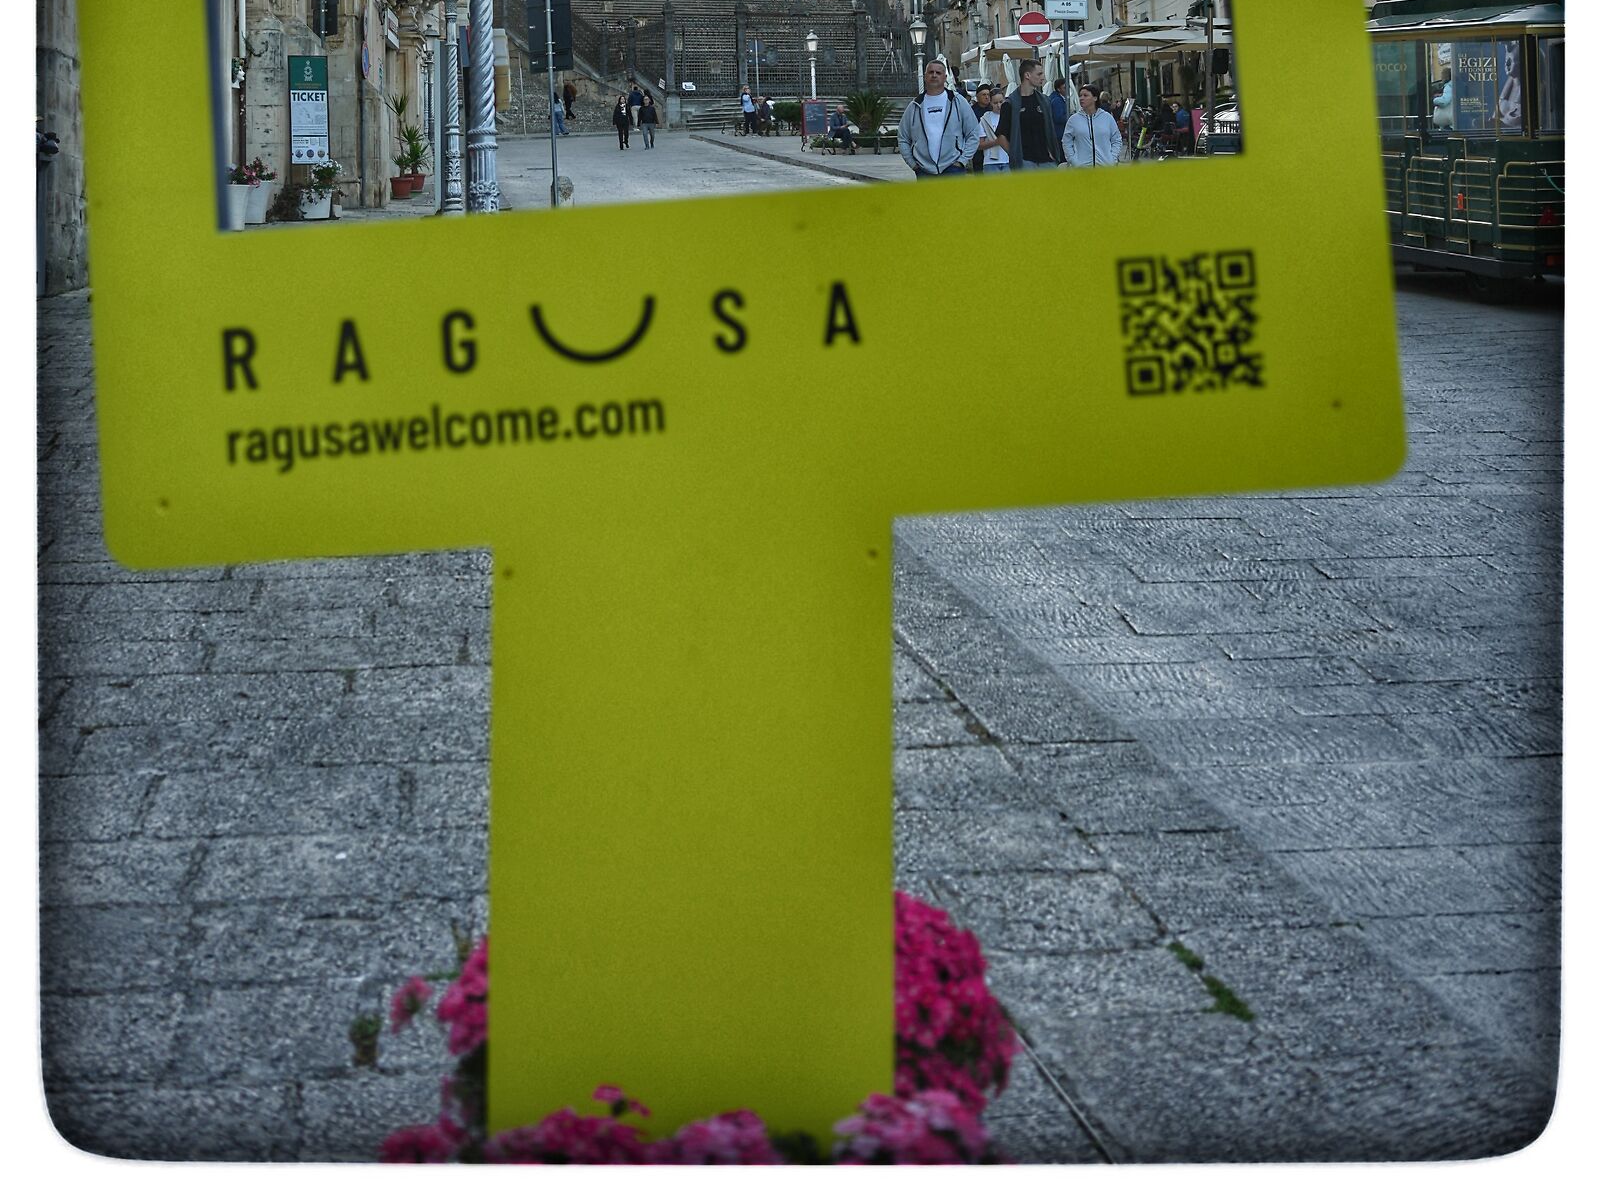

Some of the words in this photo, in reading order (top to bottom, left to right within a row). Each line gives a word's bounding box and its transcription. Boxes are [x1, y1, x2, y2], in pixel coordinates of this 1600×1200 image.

[1459, 57, 1497, 67] EGIZI
[292, 92, 326, 101] TICKET
[227, 399, 666, 473] ragusawelcome.com
